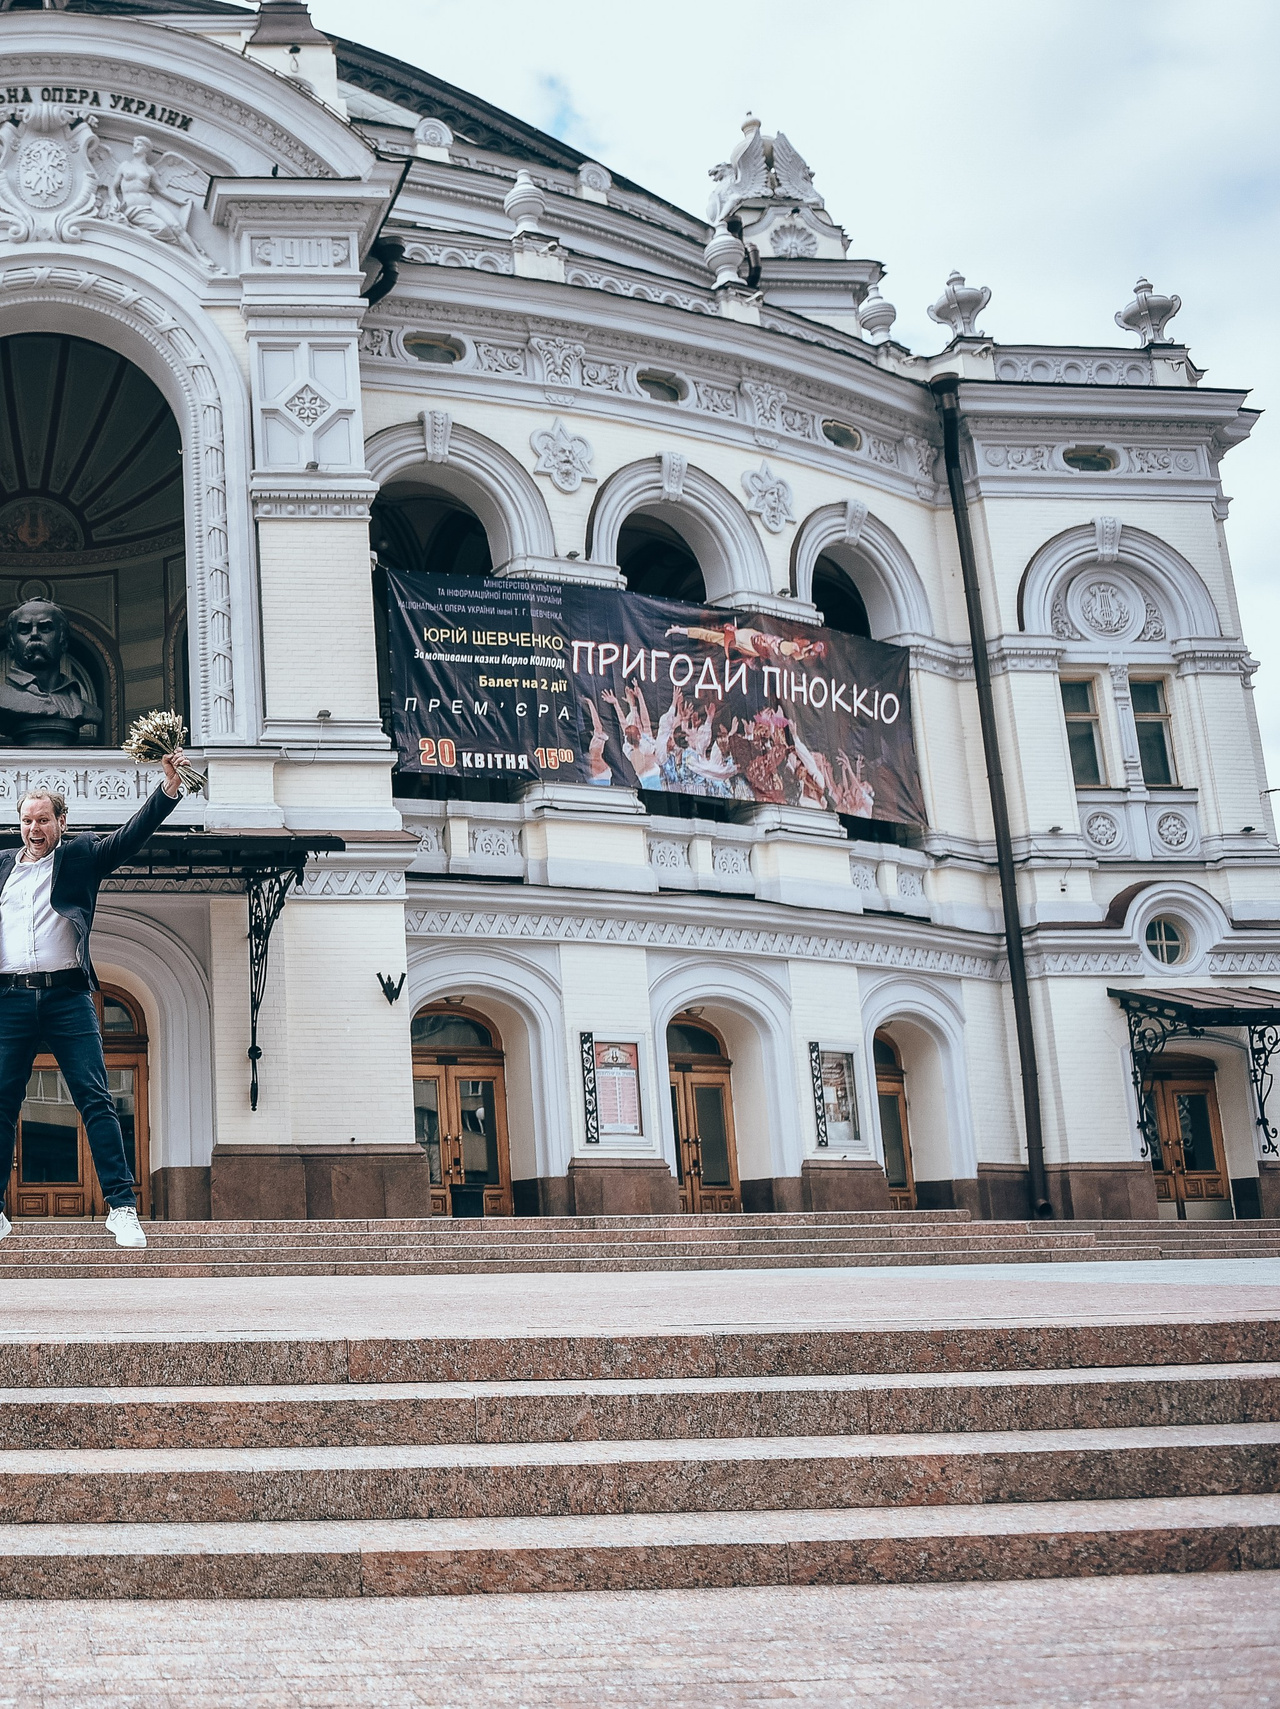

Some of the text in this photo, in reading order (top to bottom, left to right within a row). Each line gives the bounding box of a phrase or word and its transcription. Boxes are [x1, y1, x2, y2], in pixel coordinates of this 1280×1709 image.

[40, 87, 101, 107] ОПЕРА
[437, 587, 562, 605] ТА ІНФОРМАЦІЙНОЇ ПОЛІТИКИ УКРАЇНИ
[483, 579, 562, 594] МІНІСТЕРСТВО КУЛЬТУРИ
[444, 603, 466, 613] ОПЕРА
[467, 604, 496, 615] УКРАЇНИ
[530, 608, 563, 621] ШЕВЧЕНКА
[423, 627, 564, 651] ЮРІЙ ШЕВЧЕНКО
[424, 652, 473, 664] мотивами
[474, 654, 500, 665] казки
[501, 653, 529, 667] Карло
[478, 675, 568, 694] Балет на 2 дії
[571, 640, 900, 724] ПРИГОДИ ПІНОККІО
[419, 737, 457, 768] 20
[462, 751, 529, 770] КВІТНЯ
